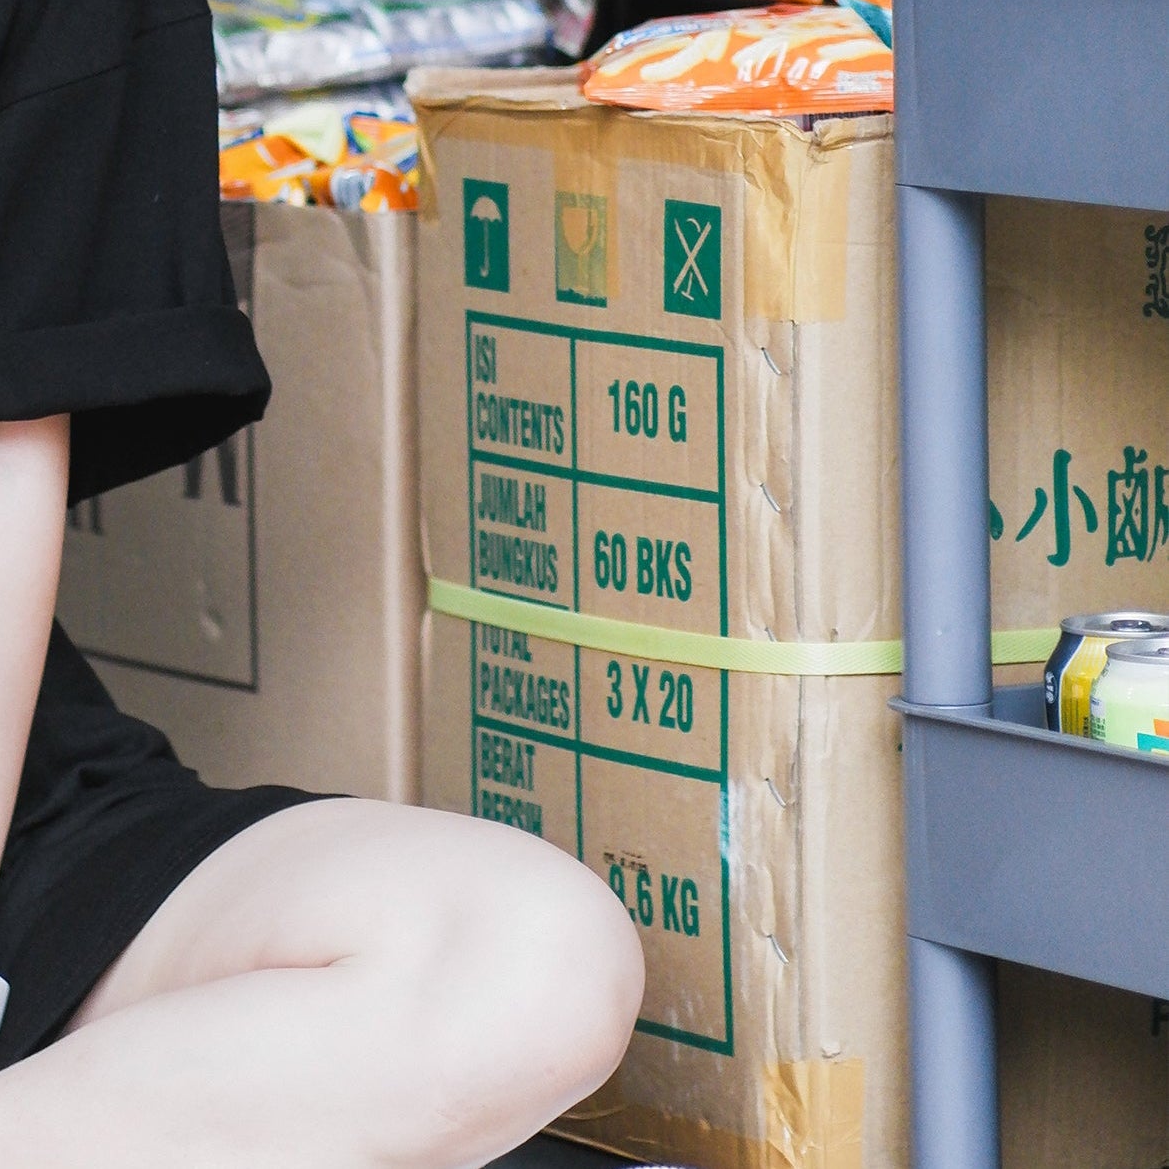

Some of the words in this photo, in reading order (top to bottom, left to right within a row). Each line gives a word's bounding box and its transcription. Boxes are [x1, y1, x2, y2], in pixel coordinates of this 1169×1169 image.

[475, 334, 497, 384] ISI
[477, 391, 565, 456] CONTENTS
[607, 379, 659, 439] 160
[668, 384, 687, 443] G
[478, 473, 547, 532] JUMLAH
[480, 530, 559, 595] BUNGKUS
[594, 530, 627, 593] 60
[636, 535, 693, 603] BKS
[481, 661, 570, 731] PACKAGES
[607, 659, 623, 719] 3
[631, 663, 650, 725] X
[658, 670, 693, 733] 20
[481, 732, 536, 792] BERAT
[661, 873, 699, 938] KG
